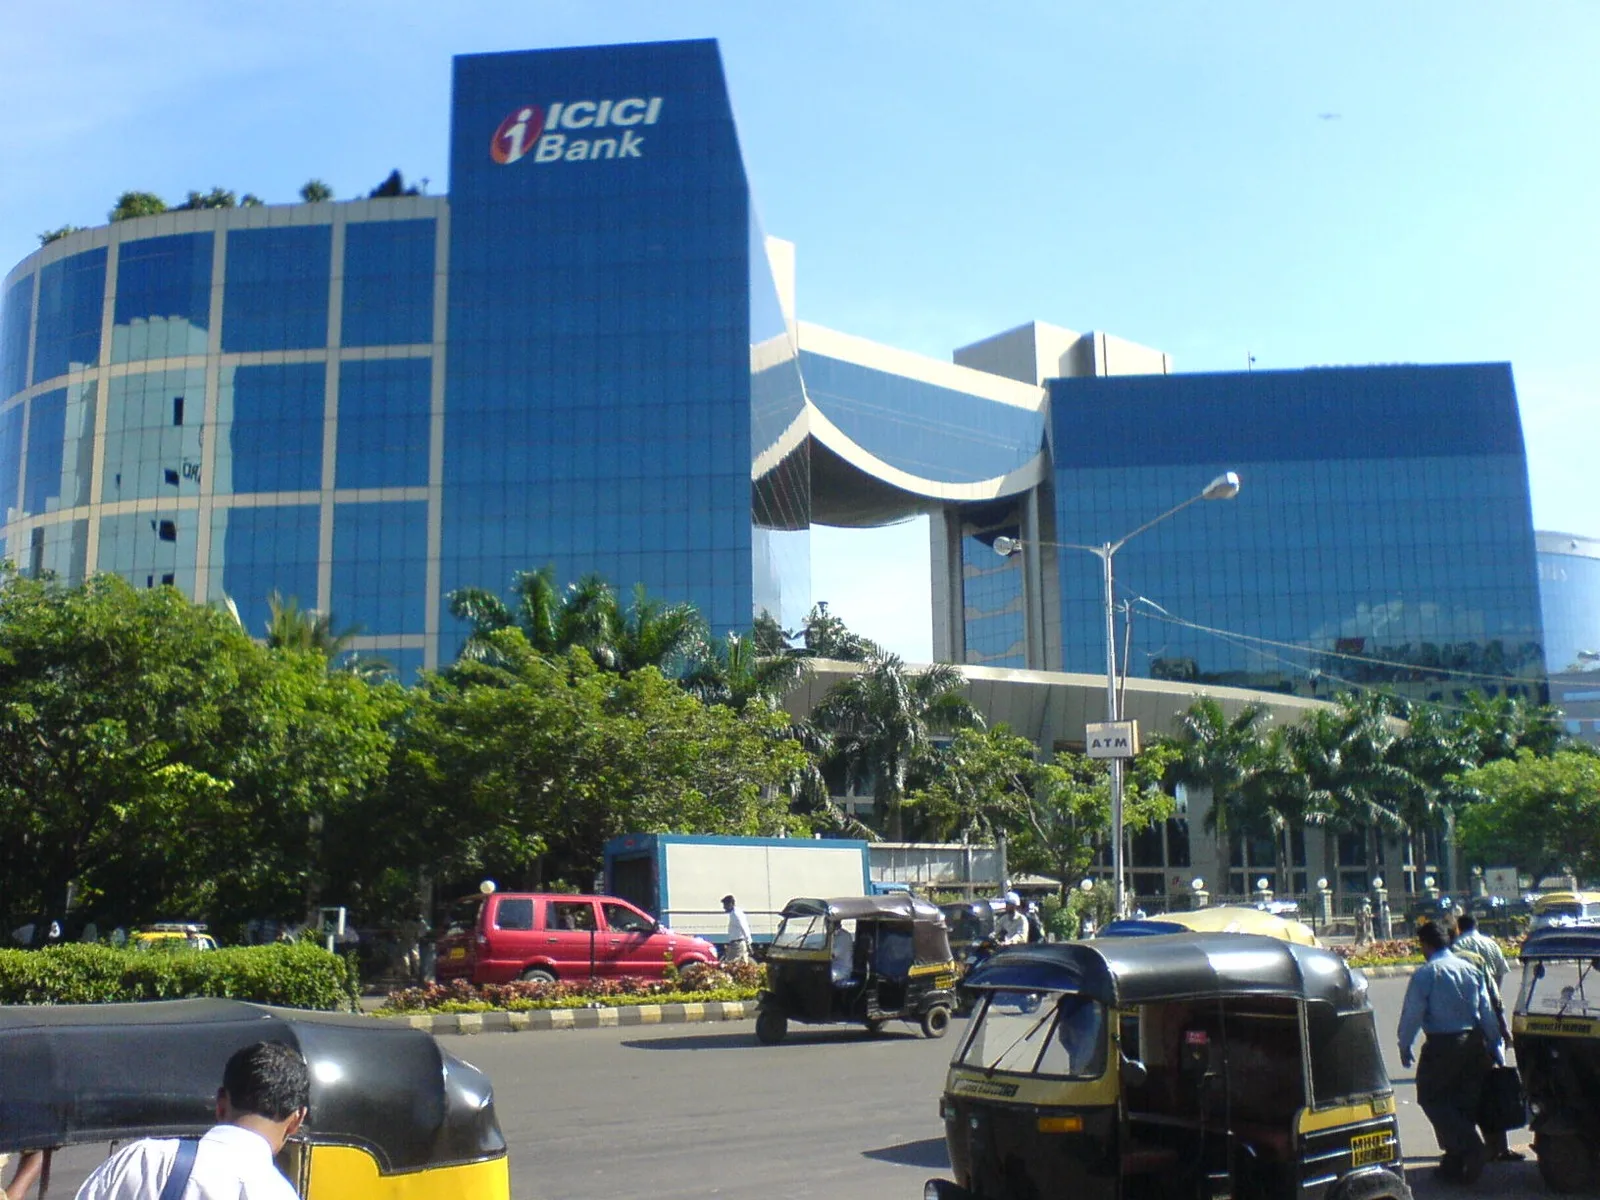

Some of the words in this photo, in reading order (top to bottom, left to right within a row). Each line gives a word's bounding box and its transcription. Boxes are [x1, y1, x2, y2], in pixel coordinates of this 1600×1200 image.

[544, 97, 663, 131] ICICI
[534, 130, 645, 163] Bank
[1092, 738, 1128, 749] ATM
